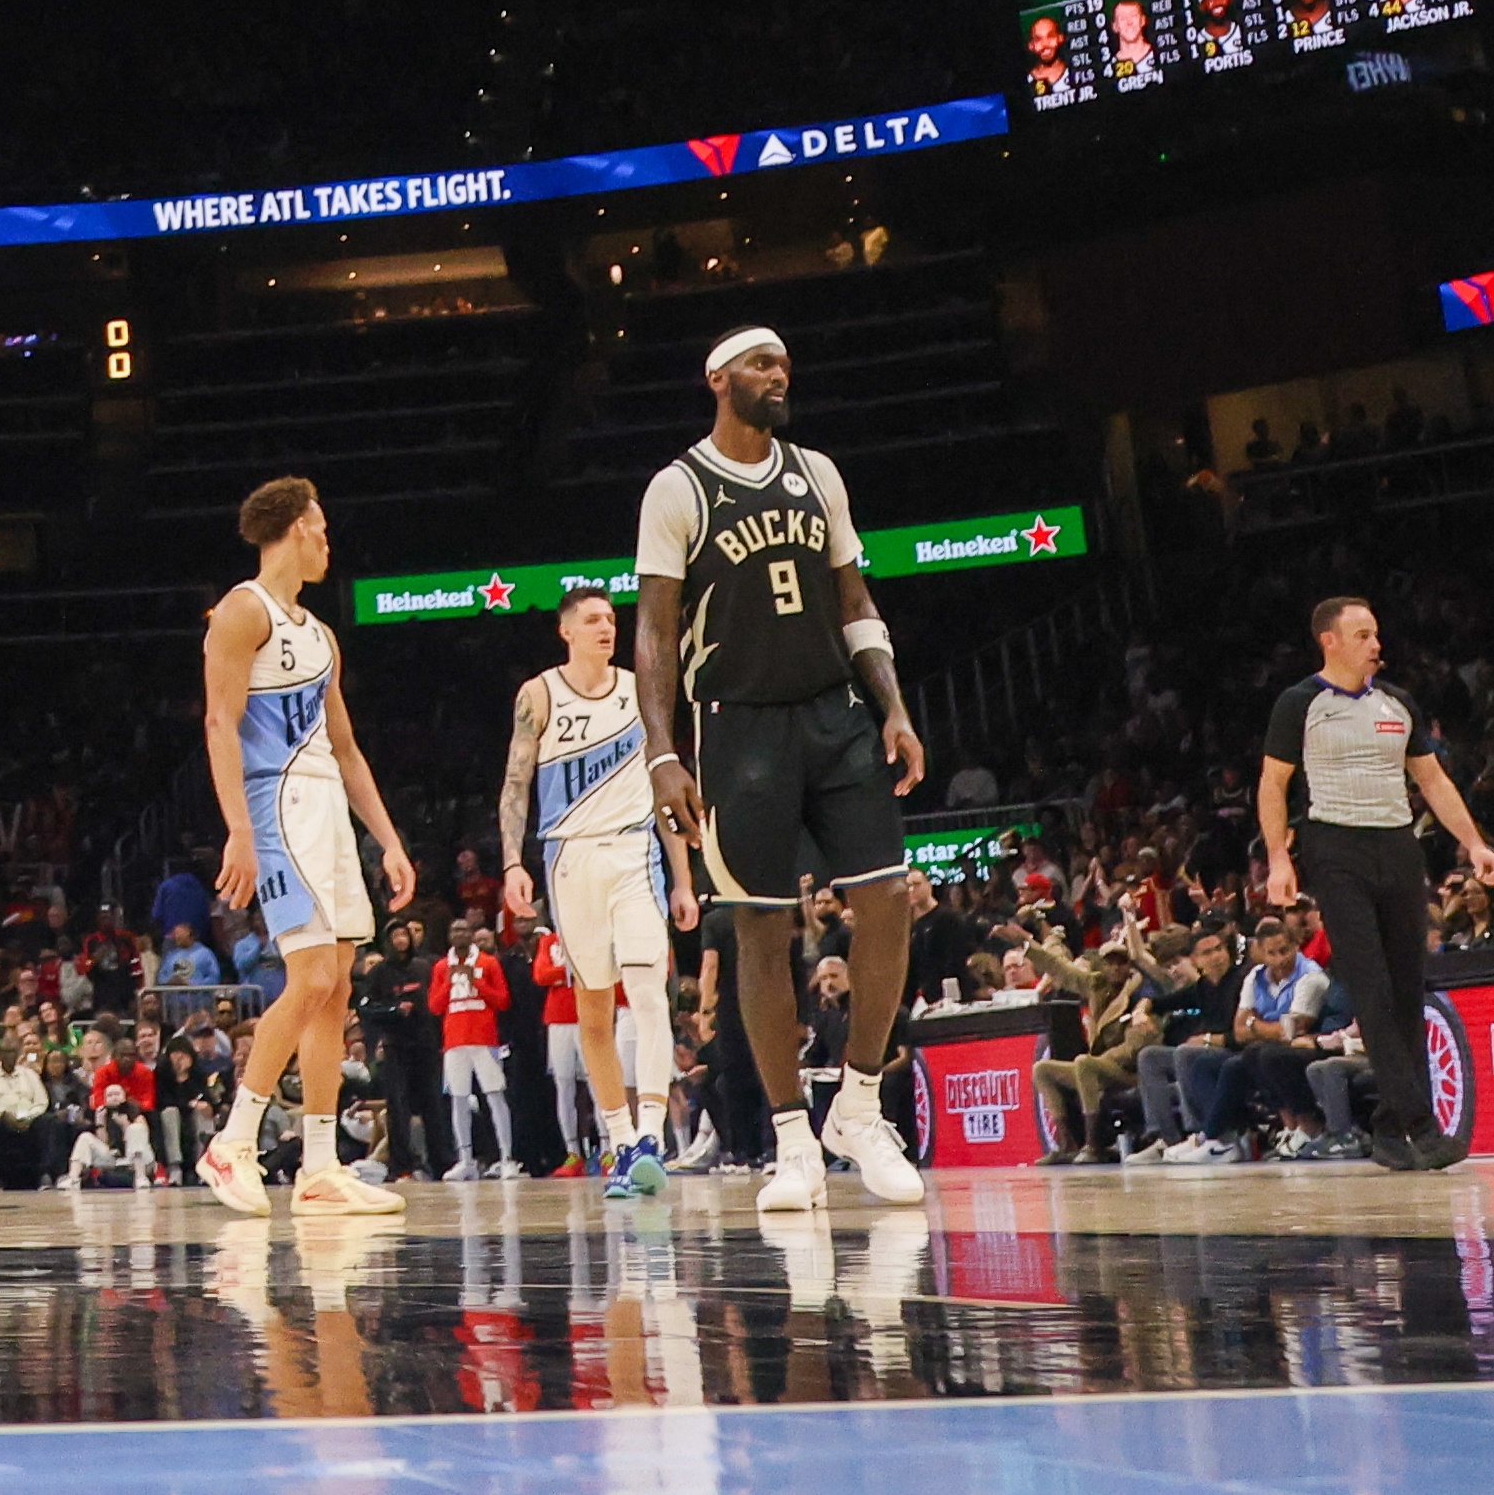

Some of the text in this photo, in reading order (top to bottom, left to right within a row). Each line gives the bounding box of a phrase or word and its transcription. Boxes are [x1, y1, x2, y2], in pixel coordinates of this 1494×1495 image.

[1382, 0, 1403, 17] 44
[1386, 0, 1474, 35] JACKSON JR.
[1291, 19, 1312, 38] 12
[1293, 28, 1347, 55] PRINCE
[1115, 60, 1135, 78] 20
[1203, 48, 1255, 74] PORTIS
[1117, 68, 1164, 94] GREEN
[1033, 85, 1099, 113] TRENT JR.
[801, 111, 941, 160] DELTA
[153, 168, 512, 232] WHERE ATL TAKES FLIGHT.
[715, 508, 829, 566] BUCKS
[915, 528, 1020, 564] Heineken
[375, 587, 476, 614] Heineken
[609, 572, 640, 593] sta
[768, 559, 804, 616] 9
[280, 638, 296, 672] 5
[556, 715, 591, 743] 27
[564, 737, 634, 808] Hawks
[915, 842, 960, 864] star
[968, 1114, 1000, 1136] TIRE
